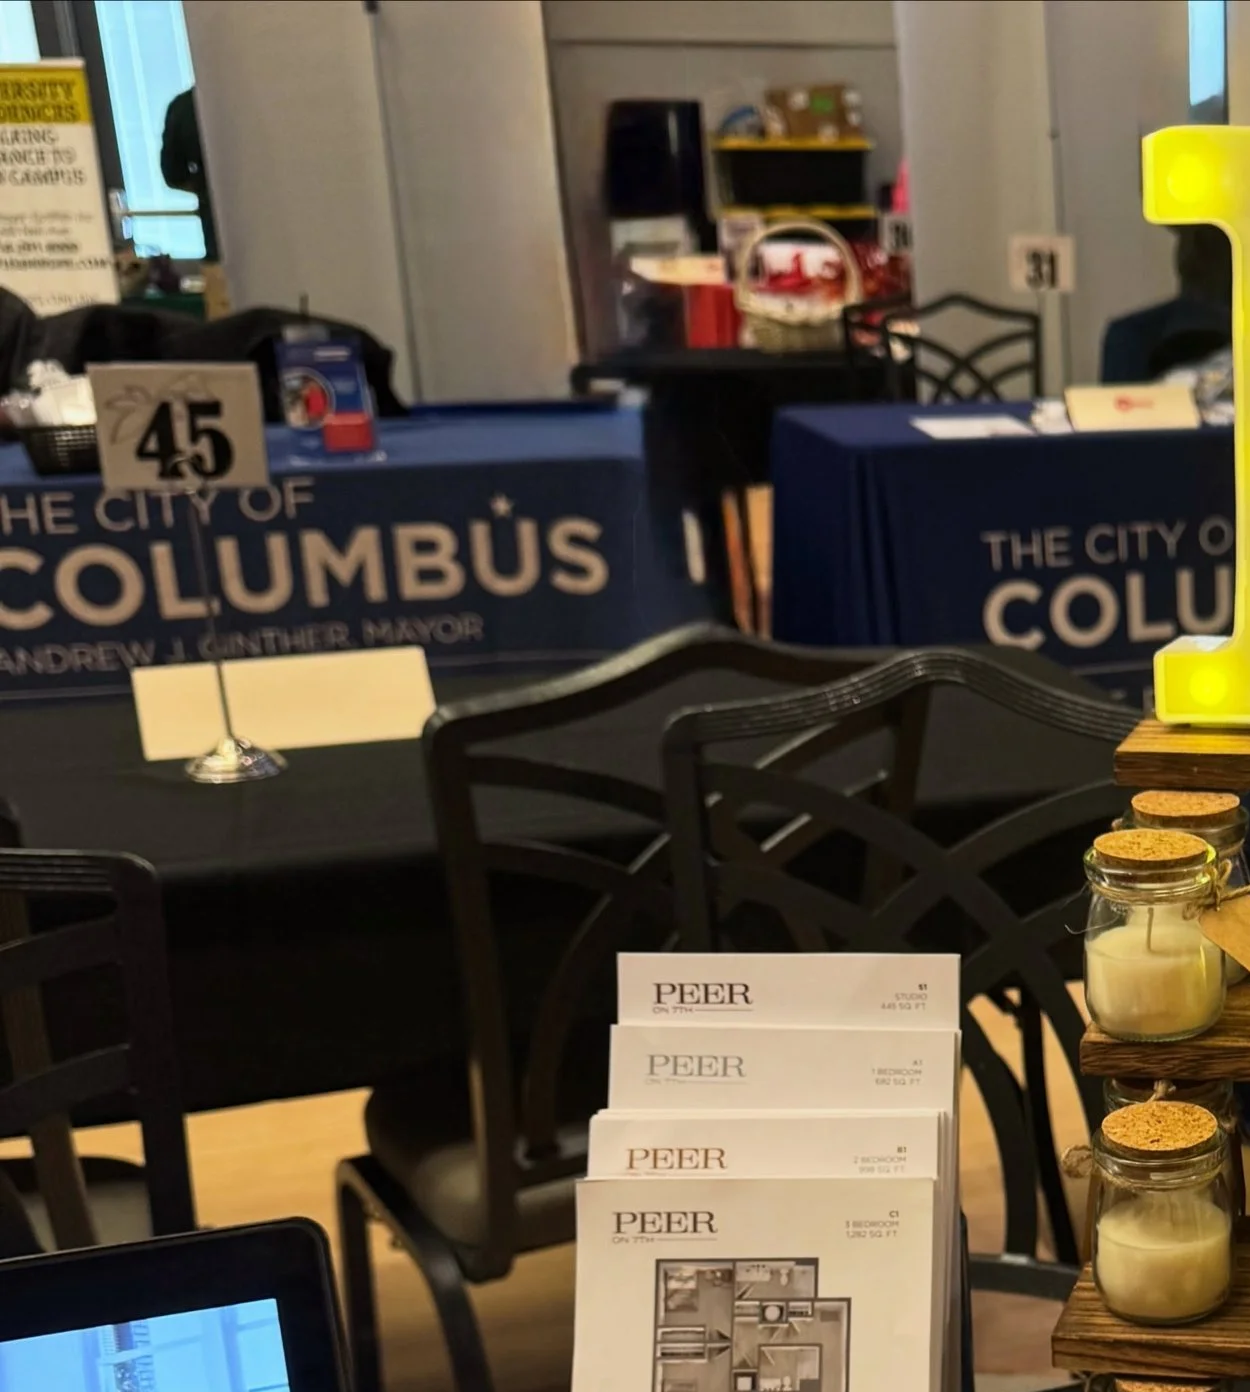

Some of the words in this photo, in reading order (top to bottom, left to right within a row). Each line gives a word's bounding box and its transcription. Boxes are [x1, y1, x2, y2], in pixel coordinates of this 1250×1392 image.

[1025, 249, 1058, 290] 31
[136, 400, 234, 481] 45
[94, 484, 221, 532] CITY
[238, 476, 315, 522] OF
[979, 524, 1076, 573] THE
[1083, 519, 1188, 566] CITY
[0, 510, 611, 631] COLUMBUS
[0, 637, 155, 677] ANDREW
[361, 610, 486, 647] MAYOR
[652, 981, 754, 1005] PEER
[894, 992, 928, 1001] STUDIO
[646, 1053, 747, 1078] PEER
[877, 1068, 923, 1076] BEDROOM
[626, 1147, 728, 1170] PEER
[861, 1156, 907, 1164] BEDROOM
[612, 1211, 718, 1234] PEER
[852, 1220, 899, 1228] BEDROOM
